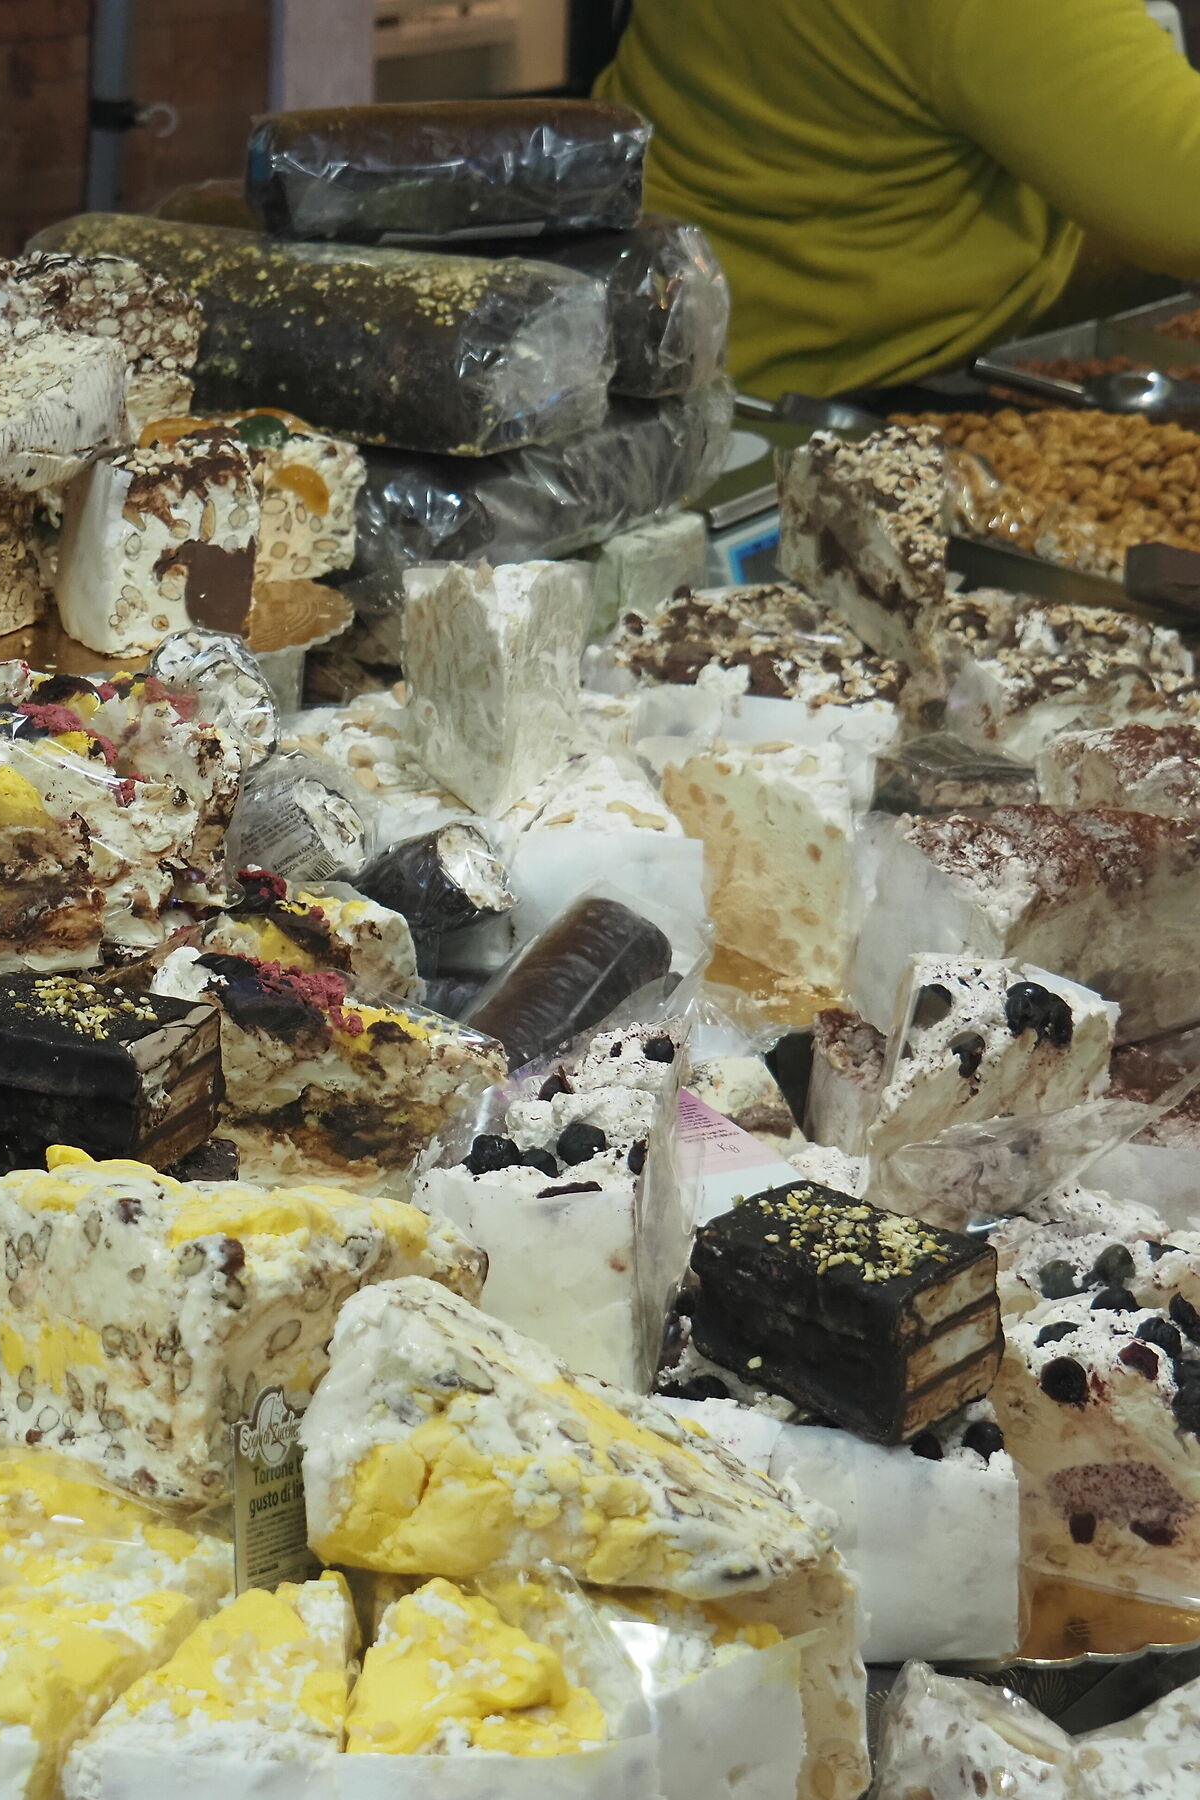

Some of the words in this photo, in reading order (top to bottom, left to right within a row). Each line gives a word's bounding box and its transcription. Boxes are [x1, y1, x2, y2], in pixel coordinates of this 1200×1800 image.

[252, 1462, 294, 1486] Torrone
[249, 1490, 279, 1518] gusto
[281, 1482, 290, 1503] di
